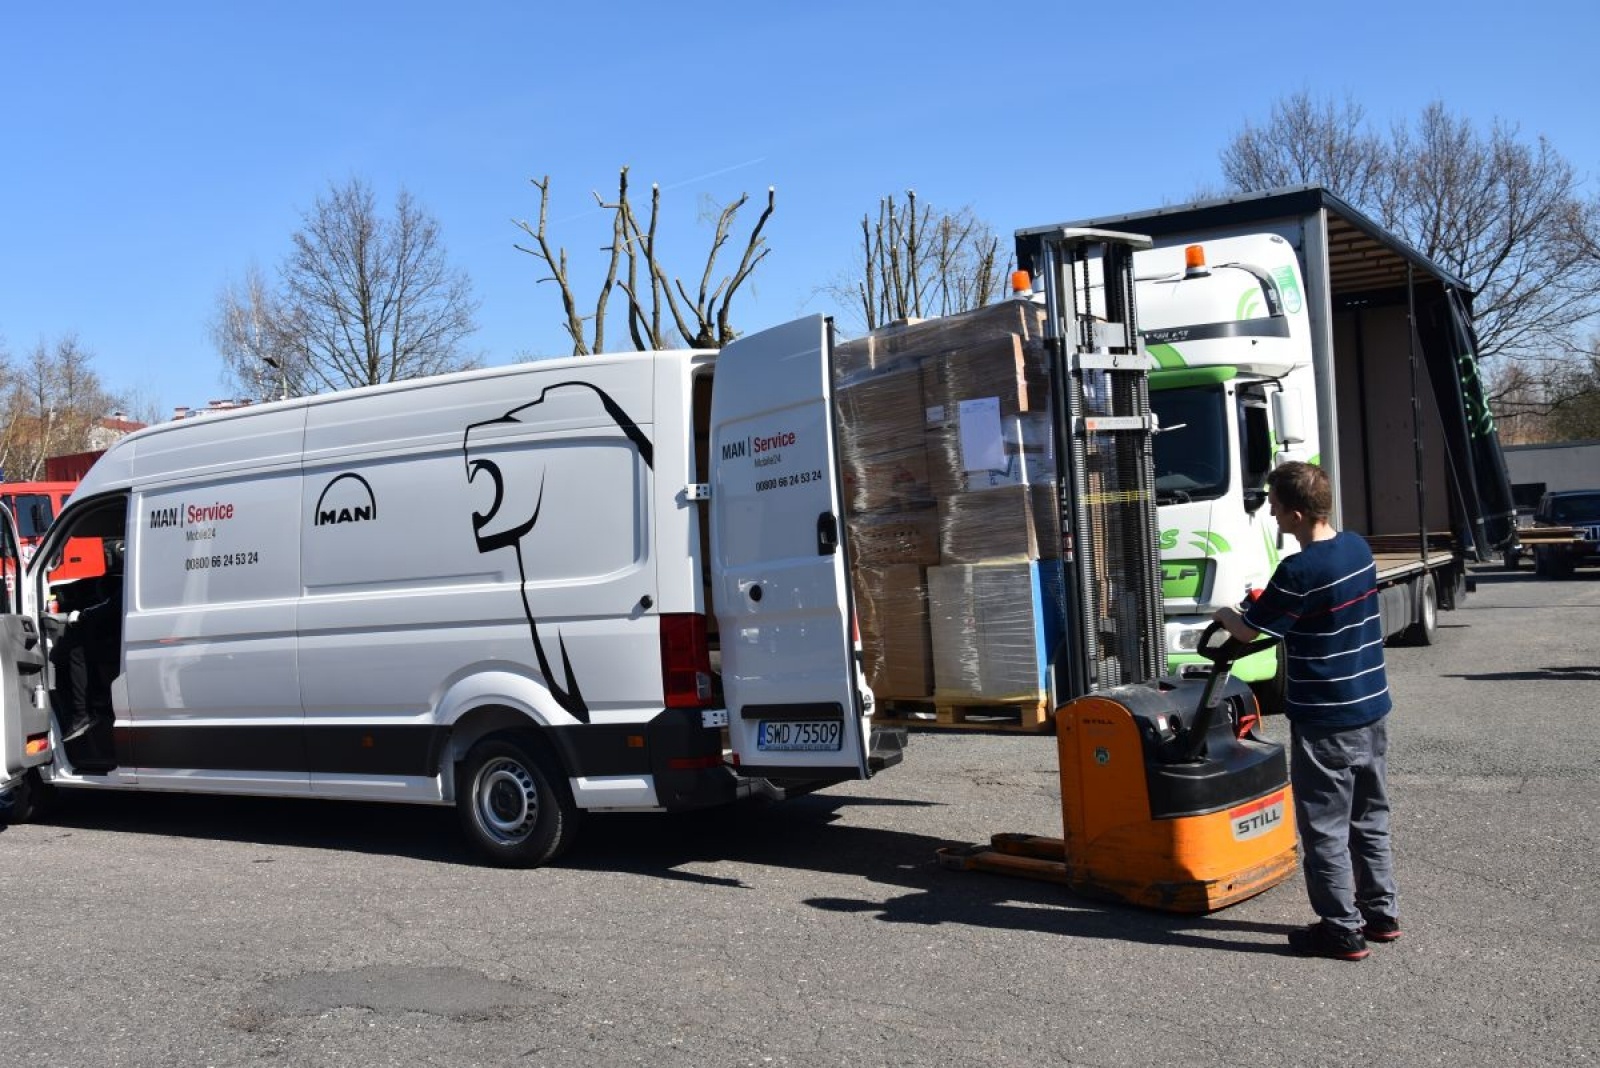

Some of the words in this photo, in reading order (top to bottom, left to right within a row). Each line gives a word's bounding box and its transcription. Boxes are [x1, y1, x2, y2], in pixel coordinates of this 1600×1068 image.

[722, 441, 745, 460] MAN
[754, 432, 796, 453] Service
[790, 474, 800, 486] 24
[801, 472, 811, 484] 53
[812, 470, 822, 481] 24
[150, 508, 178, 529] MAN
[187, 502, 234, 524] Service
[320, 506, 371, 526] MAN
[211, 555, 222, 568] 66
[223, 554, 234, 566] 24
[235, 552, 246, 565] 53
[247, 551, 259, 565] 24
[766, 723, 790, 744] SWD
[794, 723, 838, 744] 75509
[1238, 808, 1281, 835] STILL
